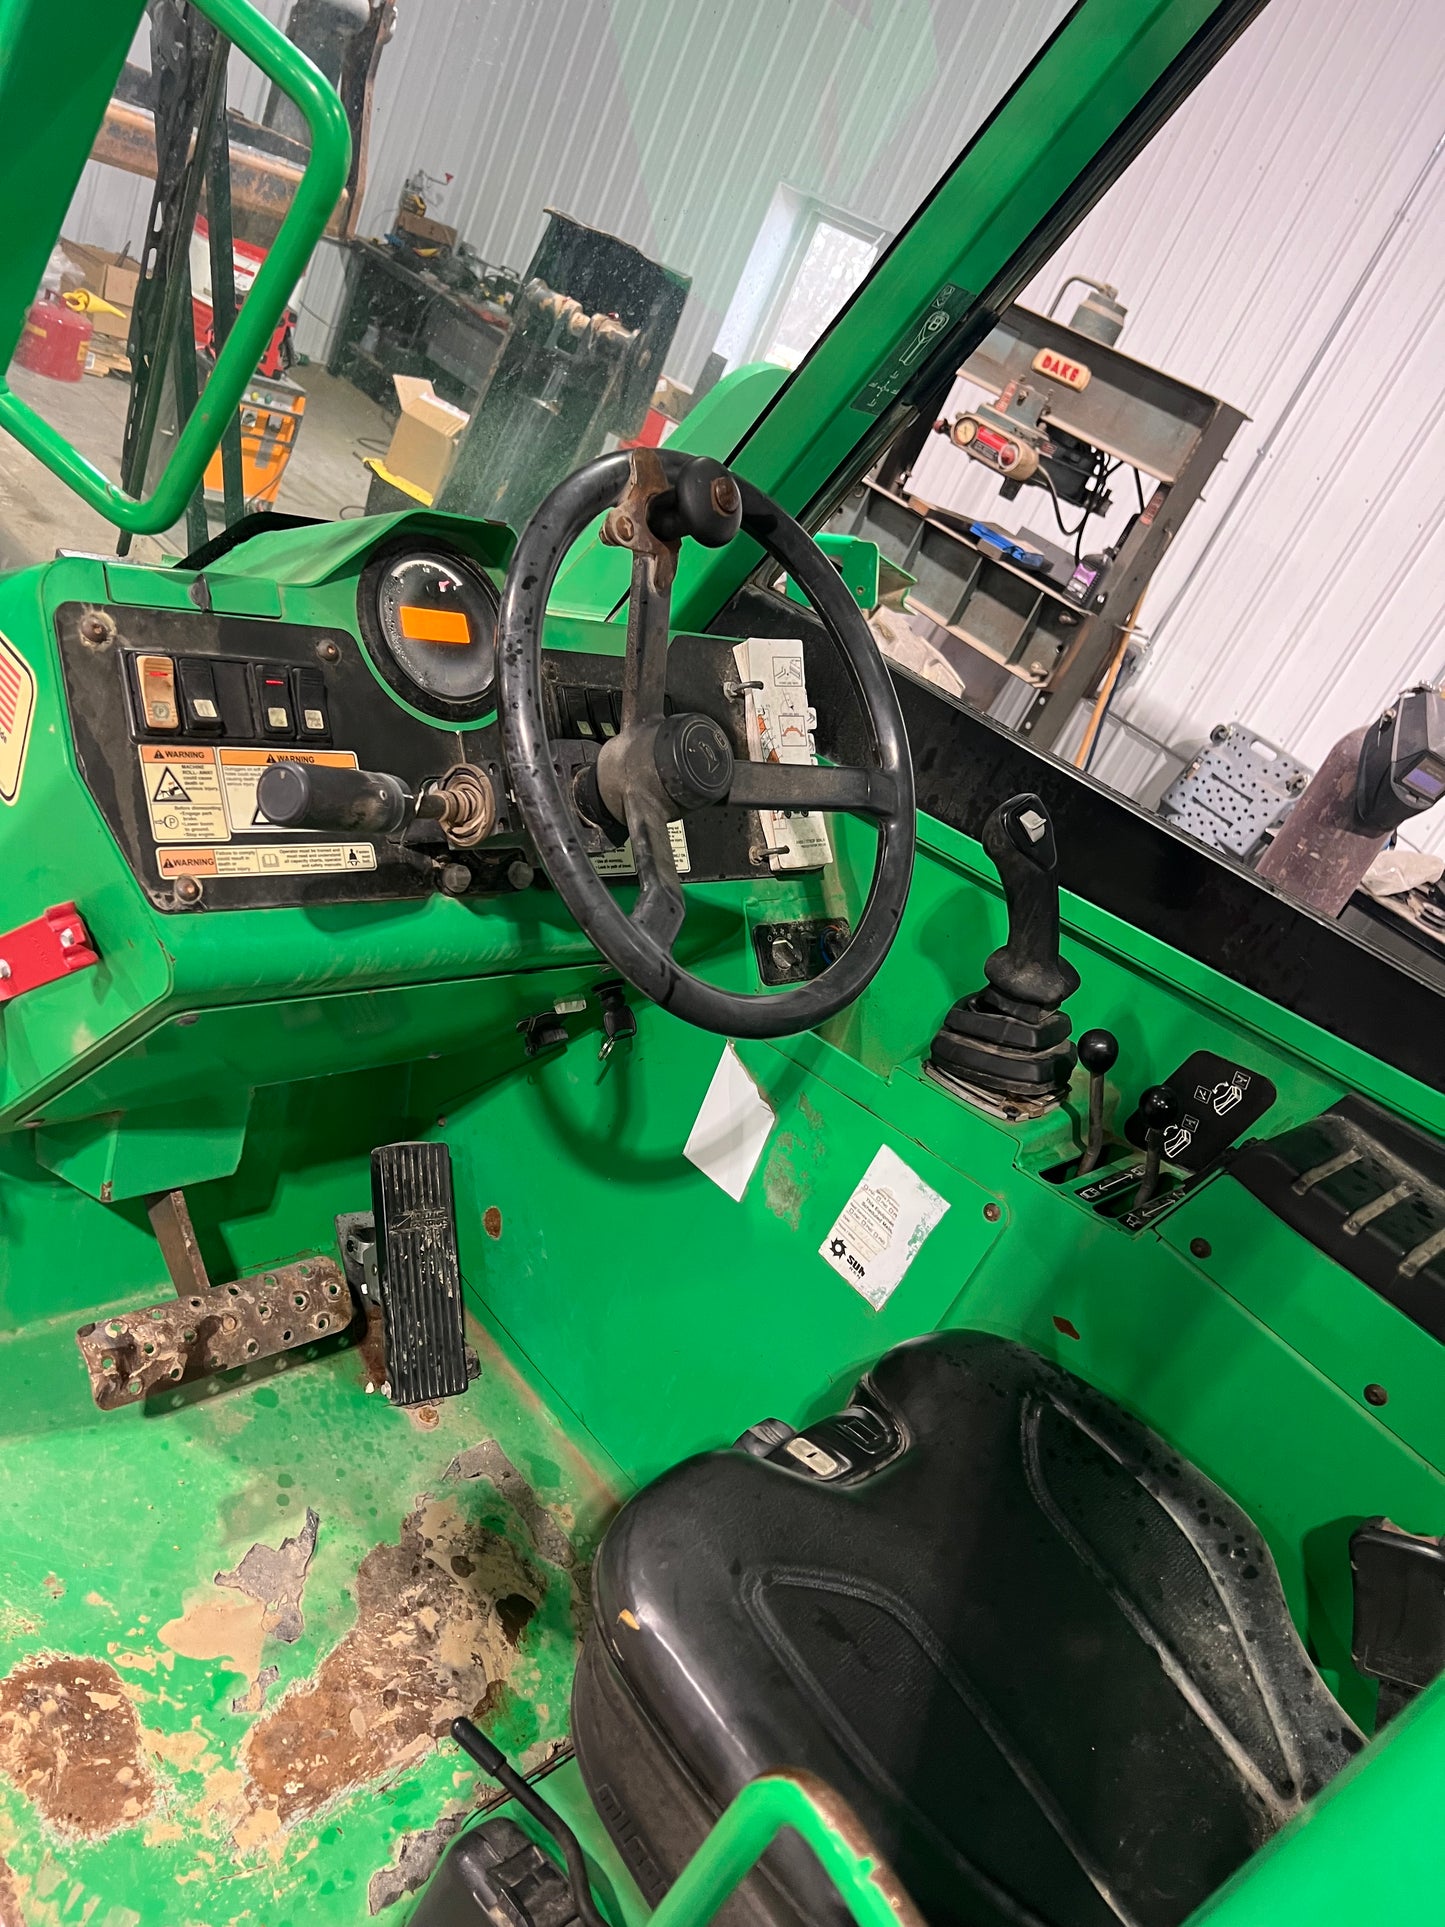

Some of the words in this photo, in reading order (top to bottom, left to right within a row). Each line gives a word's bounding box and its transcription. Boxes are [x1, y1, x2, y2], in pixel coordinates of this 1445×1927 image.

[1040, 354, 1080, 382] DAKE
[164, 750, 206, 759] WARNING
[277, 755, 315, 764] WARNING
[168, 818, 175, 827] P
[172, 858, 215, 867] WARNING
[847, 1255, 865, 1276] SUN
